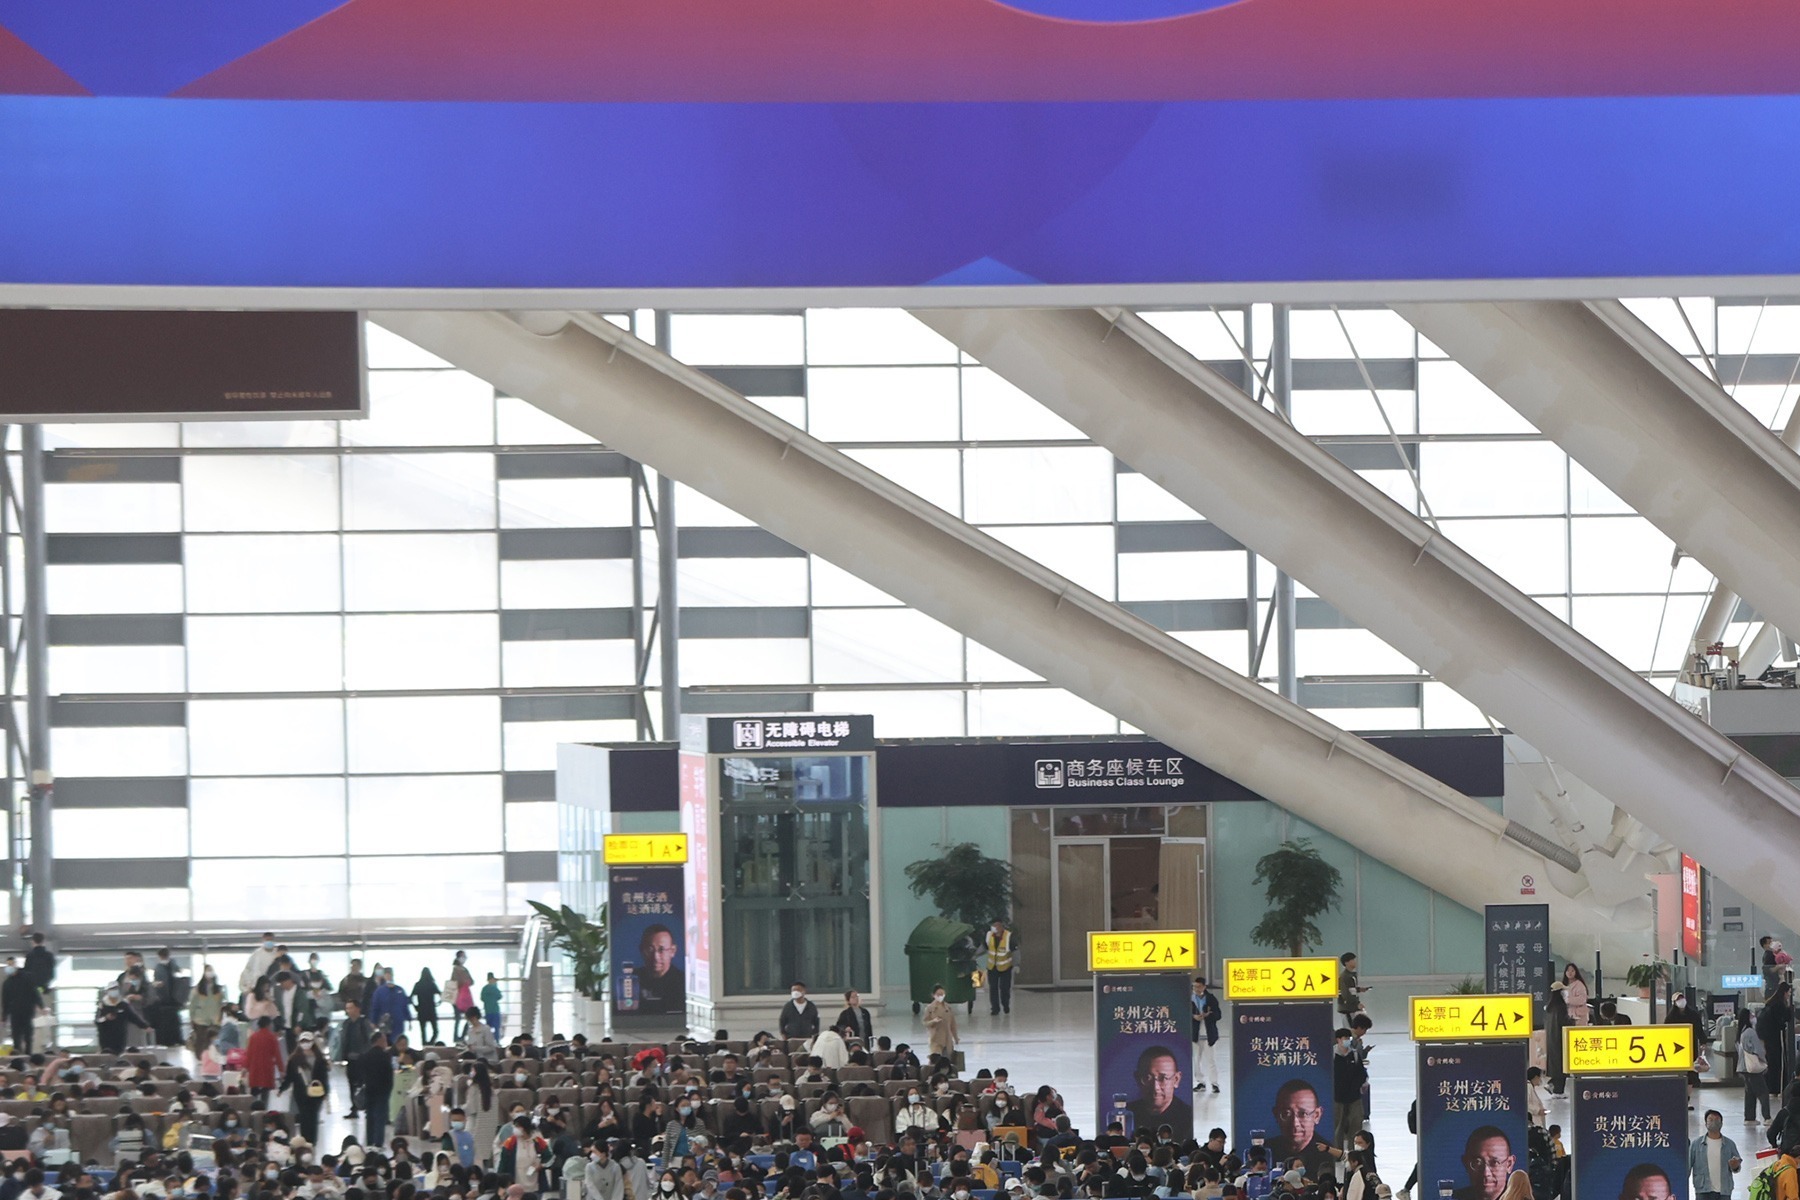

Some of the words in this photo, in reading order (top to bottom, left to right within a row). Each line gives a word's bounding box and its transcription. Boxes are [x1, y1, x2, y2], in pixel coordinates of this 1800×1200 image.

[765, 721, 850, 739] 无障碍电梯
[766, 739, 806, 748] Accessible
[808, 739, 840, 748] Elevator
[1066, 757, 1184, 777] 商务座候车区
[1068, 778, 1115, 787] Business
[1116, 777, 1145, 787] Class
[1146, 777, 1185, 788] Lounge
[647, 840, 654, 858] 1
[662, 844, 671, 858] A
[1096, 941, 1133, 953] 检票口
[1142, 940, 1157, 963] 2
[1164, 947, 1174, 963] A
[1096, 956, 1120, 964] Check
[1232, 968, 1272, 981] 检票口
[1281, 967, 1296, 992] 3
[1303, 974, 1315, 991] A
[1232, 985, 1256, 993] Check
[1263, 984, 1272, 993] in
[1113, 1005, 1170, 1019] 贵州安酒
[1419, 1006, 1461, 1020] 检票口
[1470, 1005, 1488, 1031] 4
[1495, 1012, 1507, 1031] A
[1119, 1020, 1177, 1034] 这酒讲究
[1418, 1024, 1446, 1033] Check
[1451, 1023, 1461, 1033] in
[1250, 1036, 1310, 1052] 贵州安酒
[1573, 1037, 1618, 1052] 检票口
[1628, 1036, 1646, 1064] 5
[1654, 1044, 1667, 1062] A
[1257, 1051, 1318, 1067] 这酒讲究
[1573, 1056, 1602, 1066] Check
[1609, 1056, 1618, 1065] in
[1437, 1079, 1502, 1096] 贵州安酒
[1445, 1096, 1510, 1112] 这酒讲究
[1593, 1115, 1662, 1132] 贵州安酒
[1601, 1131, 1670, 1149] 这酒讲究
